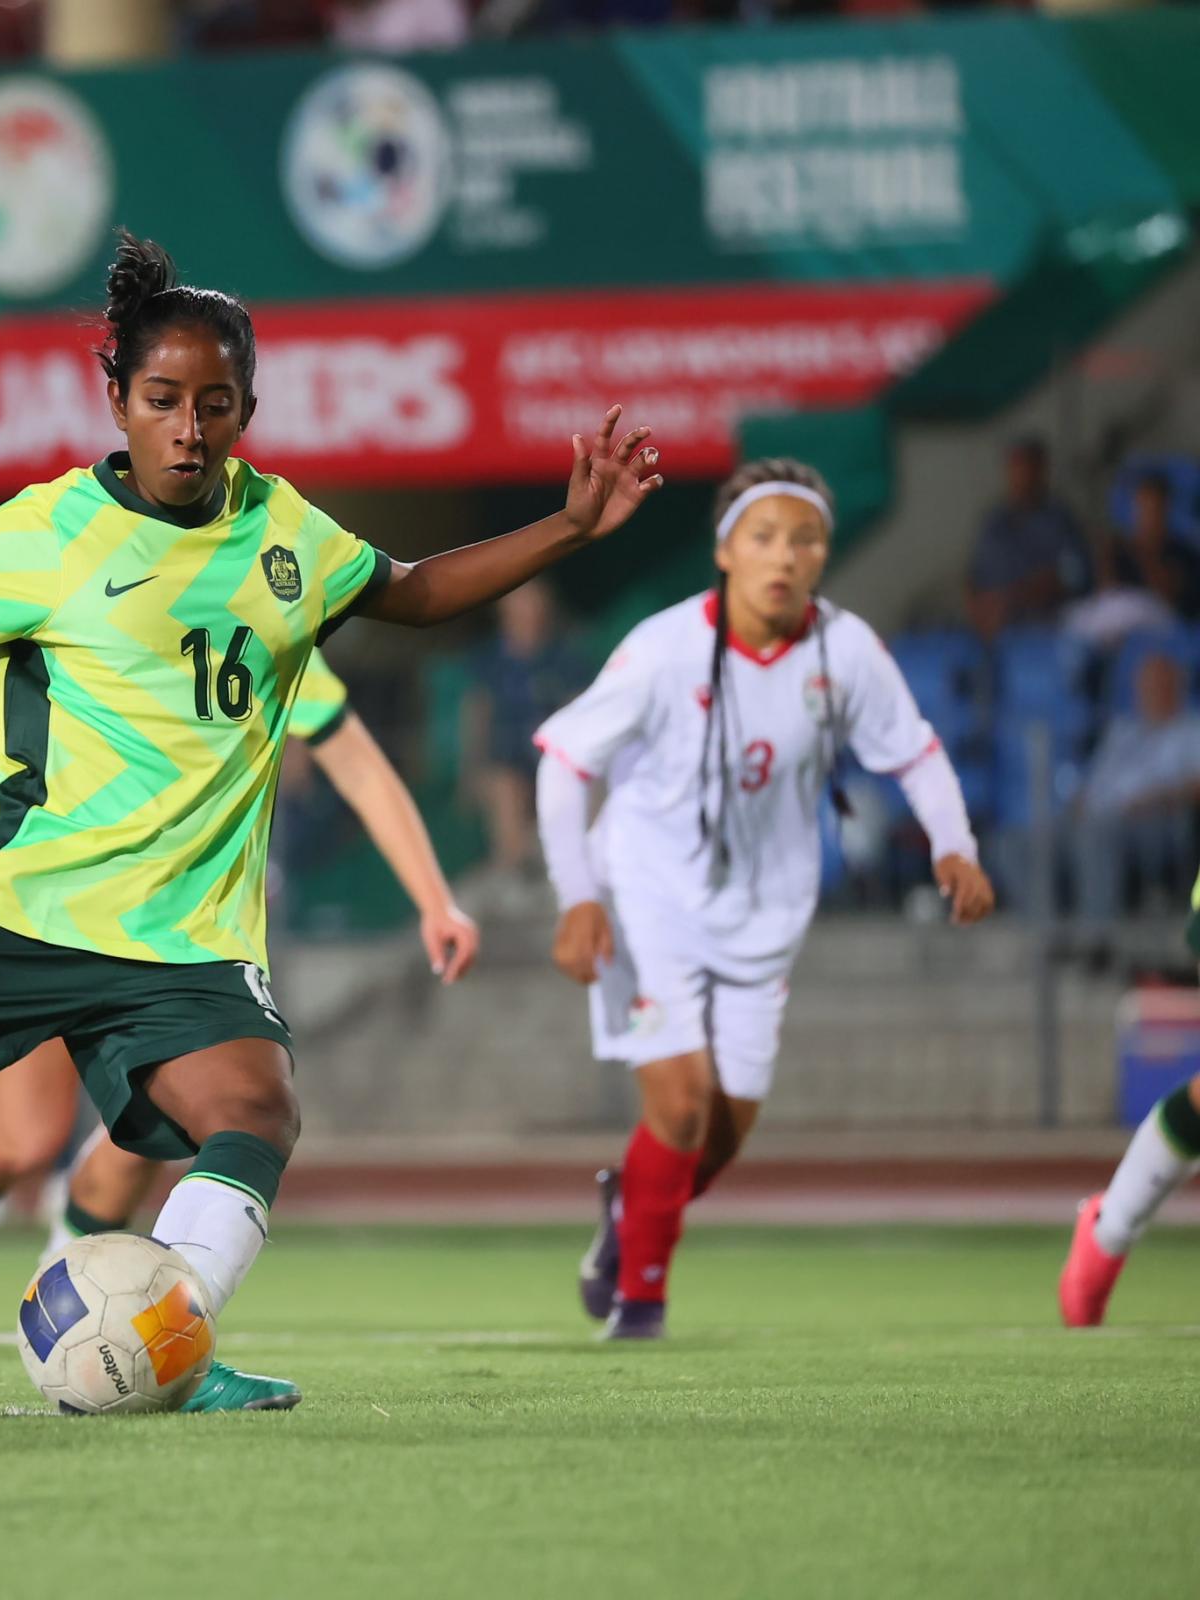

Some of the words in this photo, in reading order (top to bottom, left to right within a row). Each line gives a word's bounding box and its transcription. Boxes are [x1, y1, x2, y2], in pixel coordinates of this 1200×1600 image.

[181, 626, 253, 721] 16
[740, 738, 775, 794] 3
[99, 1344, 130, 1395] molten
